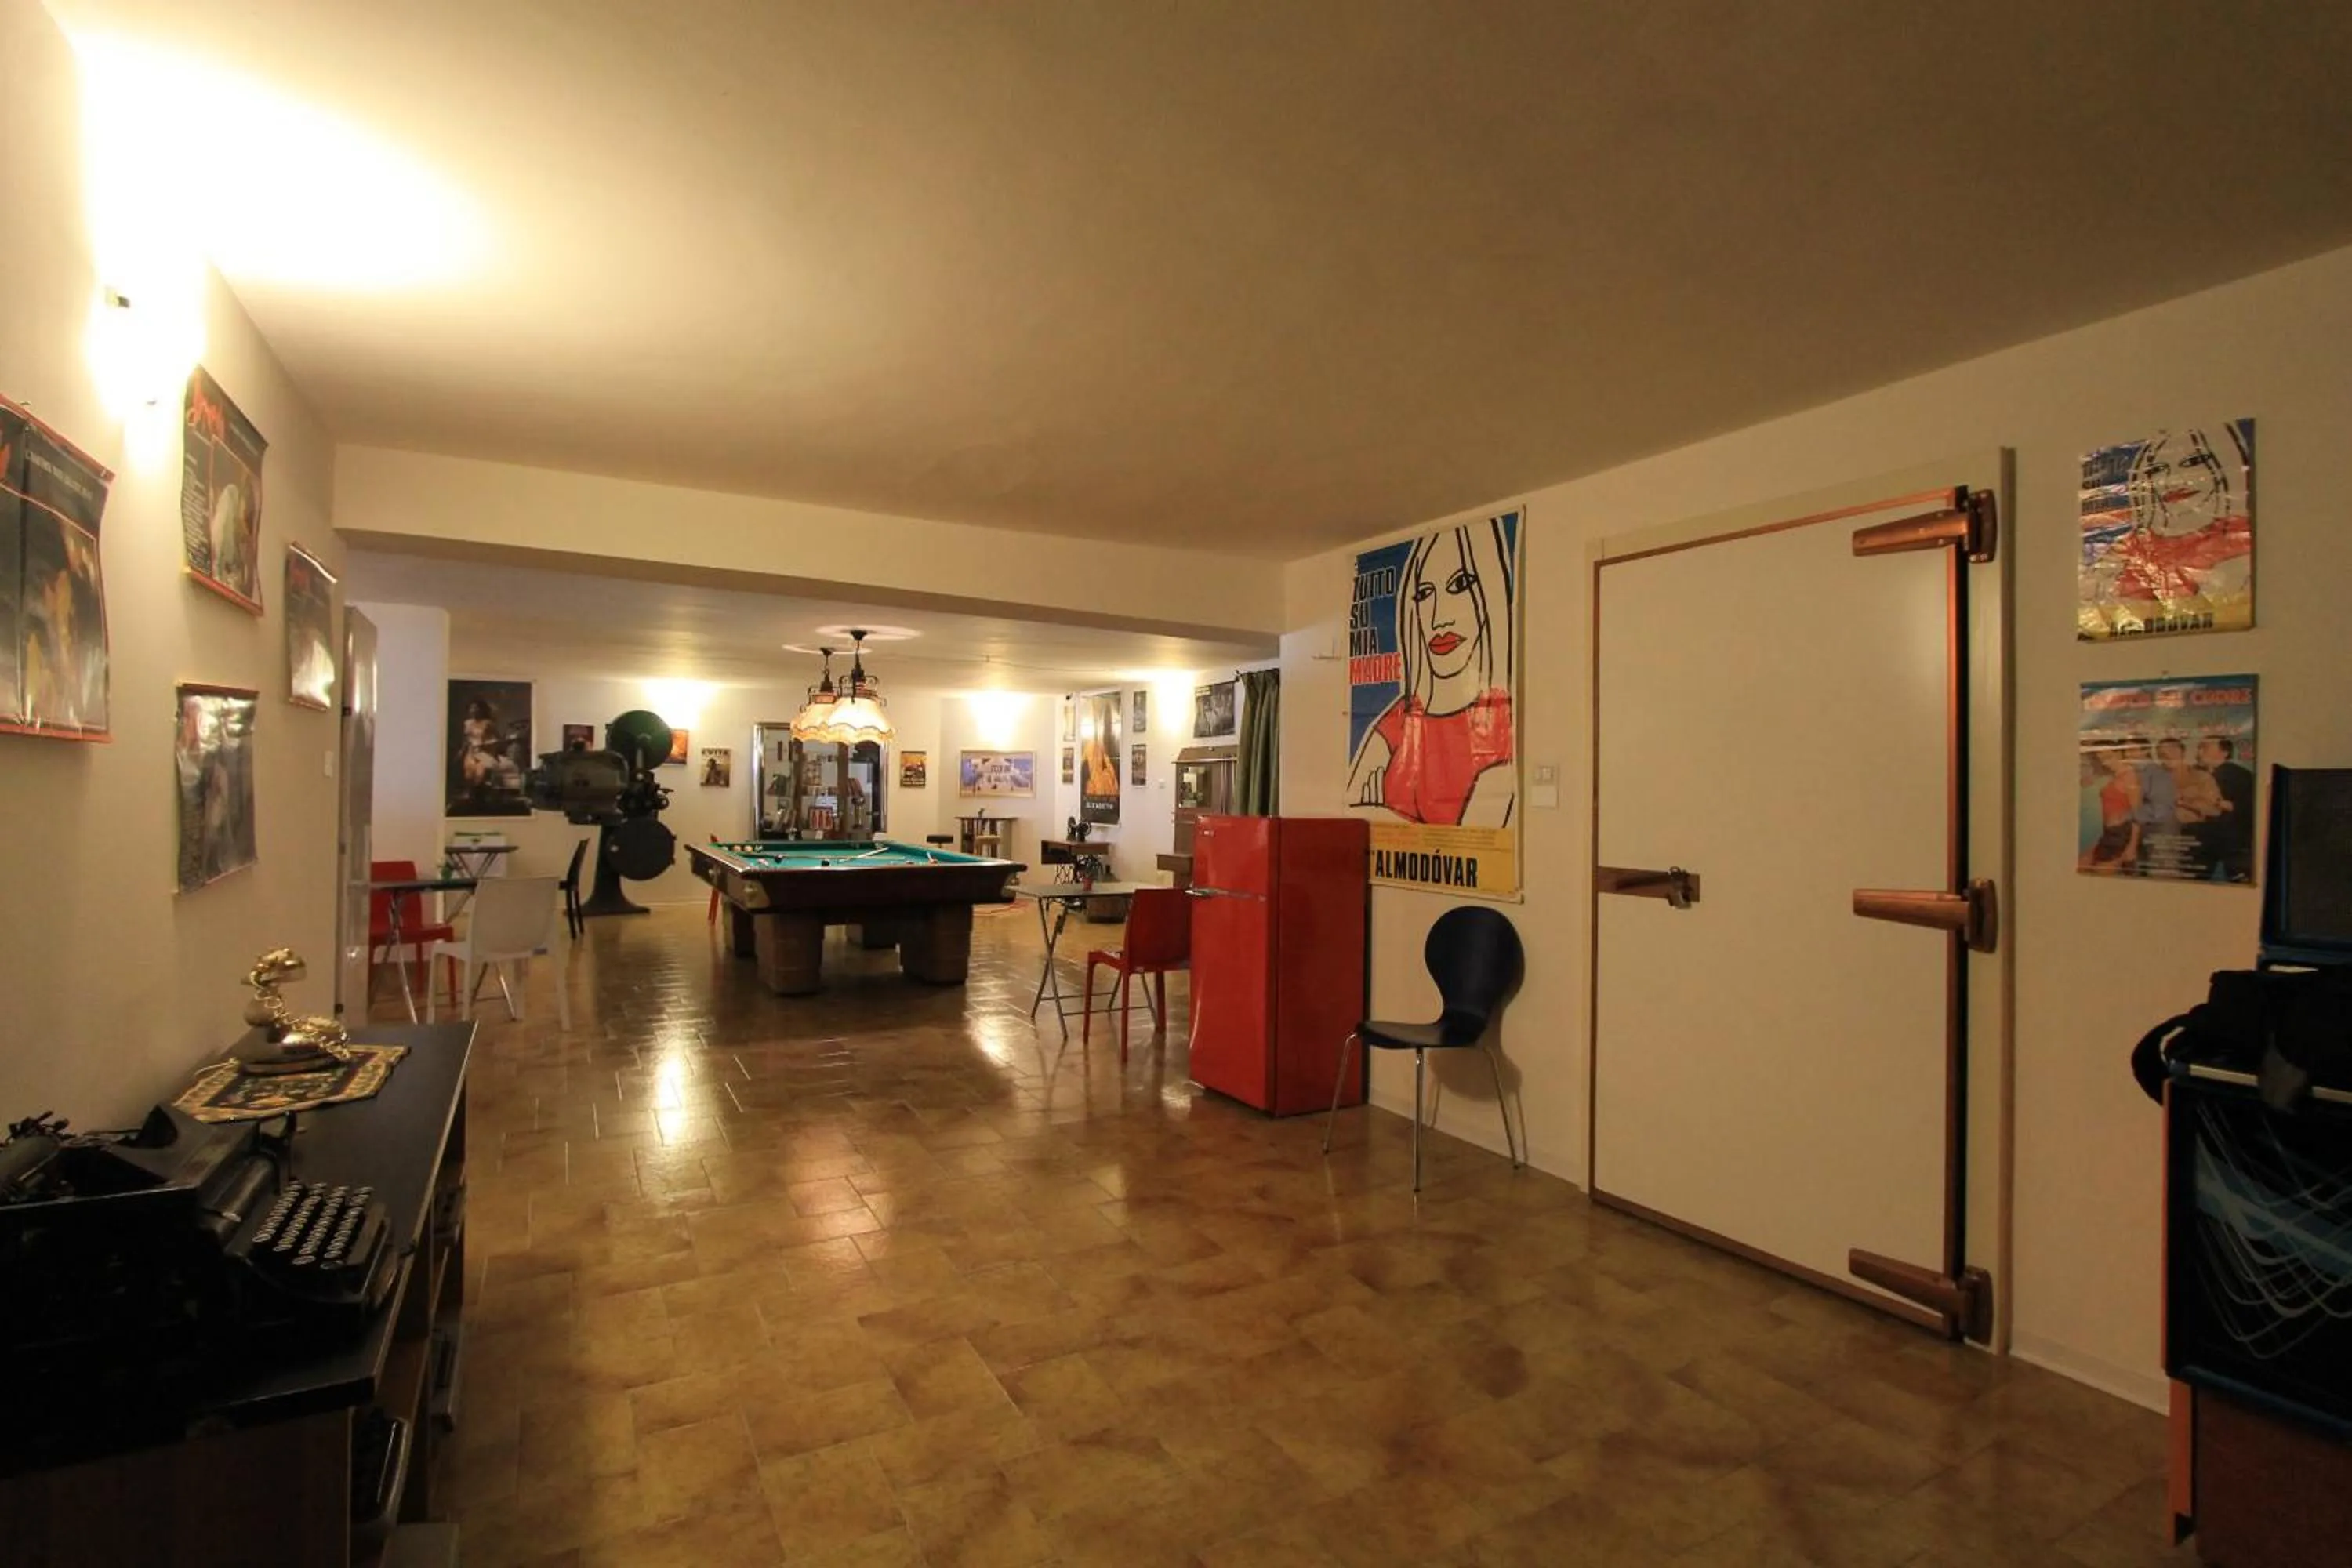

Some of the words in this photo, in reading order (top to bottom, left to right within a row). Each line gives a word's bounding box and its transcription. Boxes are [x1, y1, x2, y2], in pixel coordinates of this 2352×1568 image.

[1352, 566, 1396, 604] TUTTO
[1349, 601, 1371, 630] SU
[1349, 626, 1379, 659] MIA
[1348, 652, 1403, 685] MADRE
[1375, 848, 1478, 888] ALMODÓVAR
